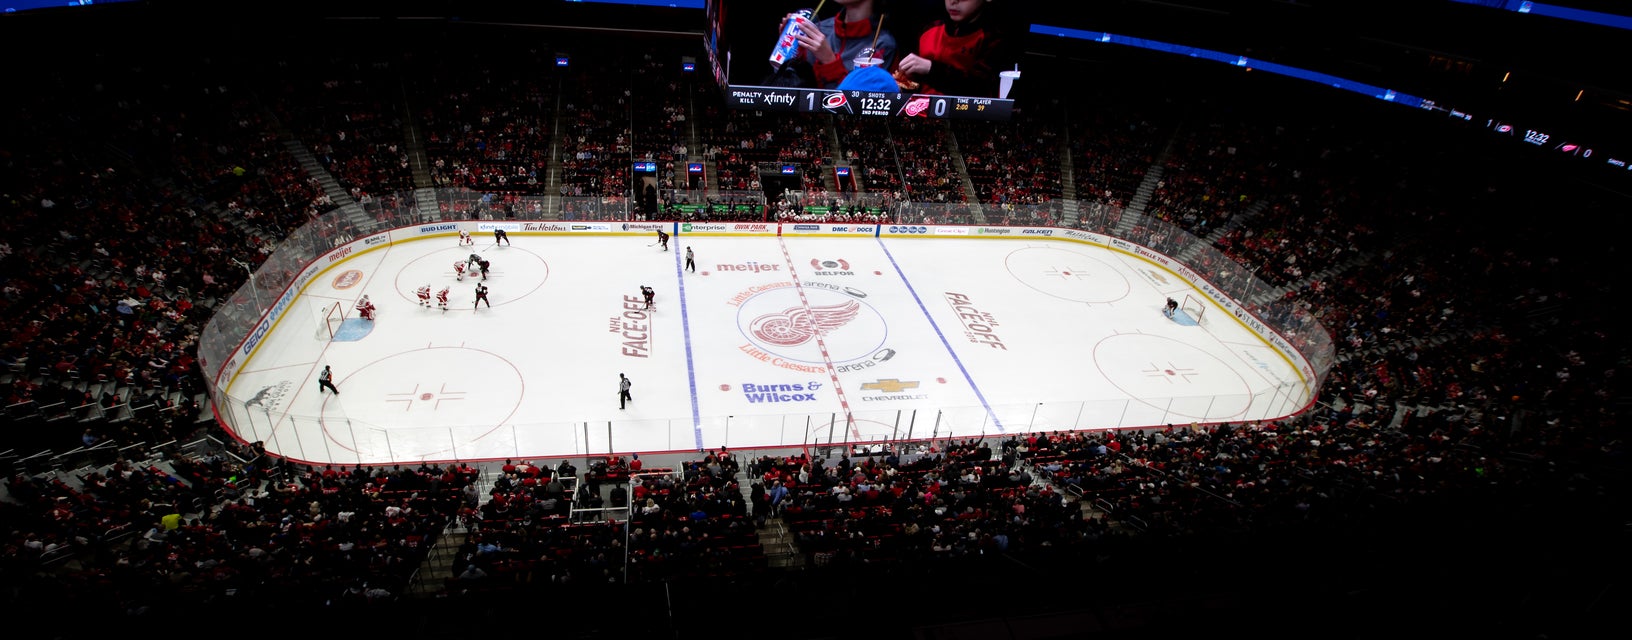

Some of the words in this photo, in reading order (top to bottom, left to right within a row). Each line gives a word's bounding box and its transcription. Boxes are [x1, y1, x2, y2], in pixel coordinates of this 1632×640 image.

[732, 91, 762, 99] PENALTY
[764, 91, 796, 106] xfinity
[806, 92, 815, 111] 1
[860, 98, 891, 110] 12:32
[935, 99, 946, 117] 0
[1525, 129, 1550, 144] 12:32
[1583, 148, 1592, 158] 0
[524, 223, 539, 231] Tim
[538, 223, 566, 232] Hortons
[984, 227, 1010, 235] Huntington
[328, 246, 353, 262] meijer
[1140, 250, 1156, 260] BELLE
[1157, 256, 1169, 266] TIRE
[716, 261, 780, 273] meijer
[803, 280, 840, 291] arena
[609, 316, 621, 333] NHL
[622, 294, 648, 358] FACE-OFF
[945, 291, 1008, 351] FACE-OFF
[243, 319, 270, 355] GEICO
[738, 342, 770, 362] Little
[771, 357, 827, 374] Caesars
[837, 359, 876, 373] arena
[741, 382, 804, 393] Burns
[807, 381, 823, 390] &
[744, 391, 817, 404] Wilcox
[862, 394, 928, 402] CHEVROLET
